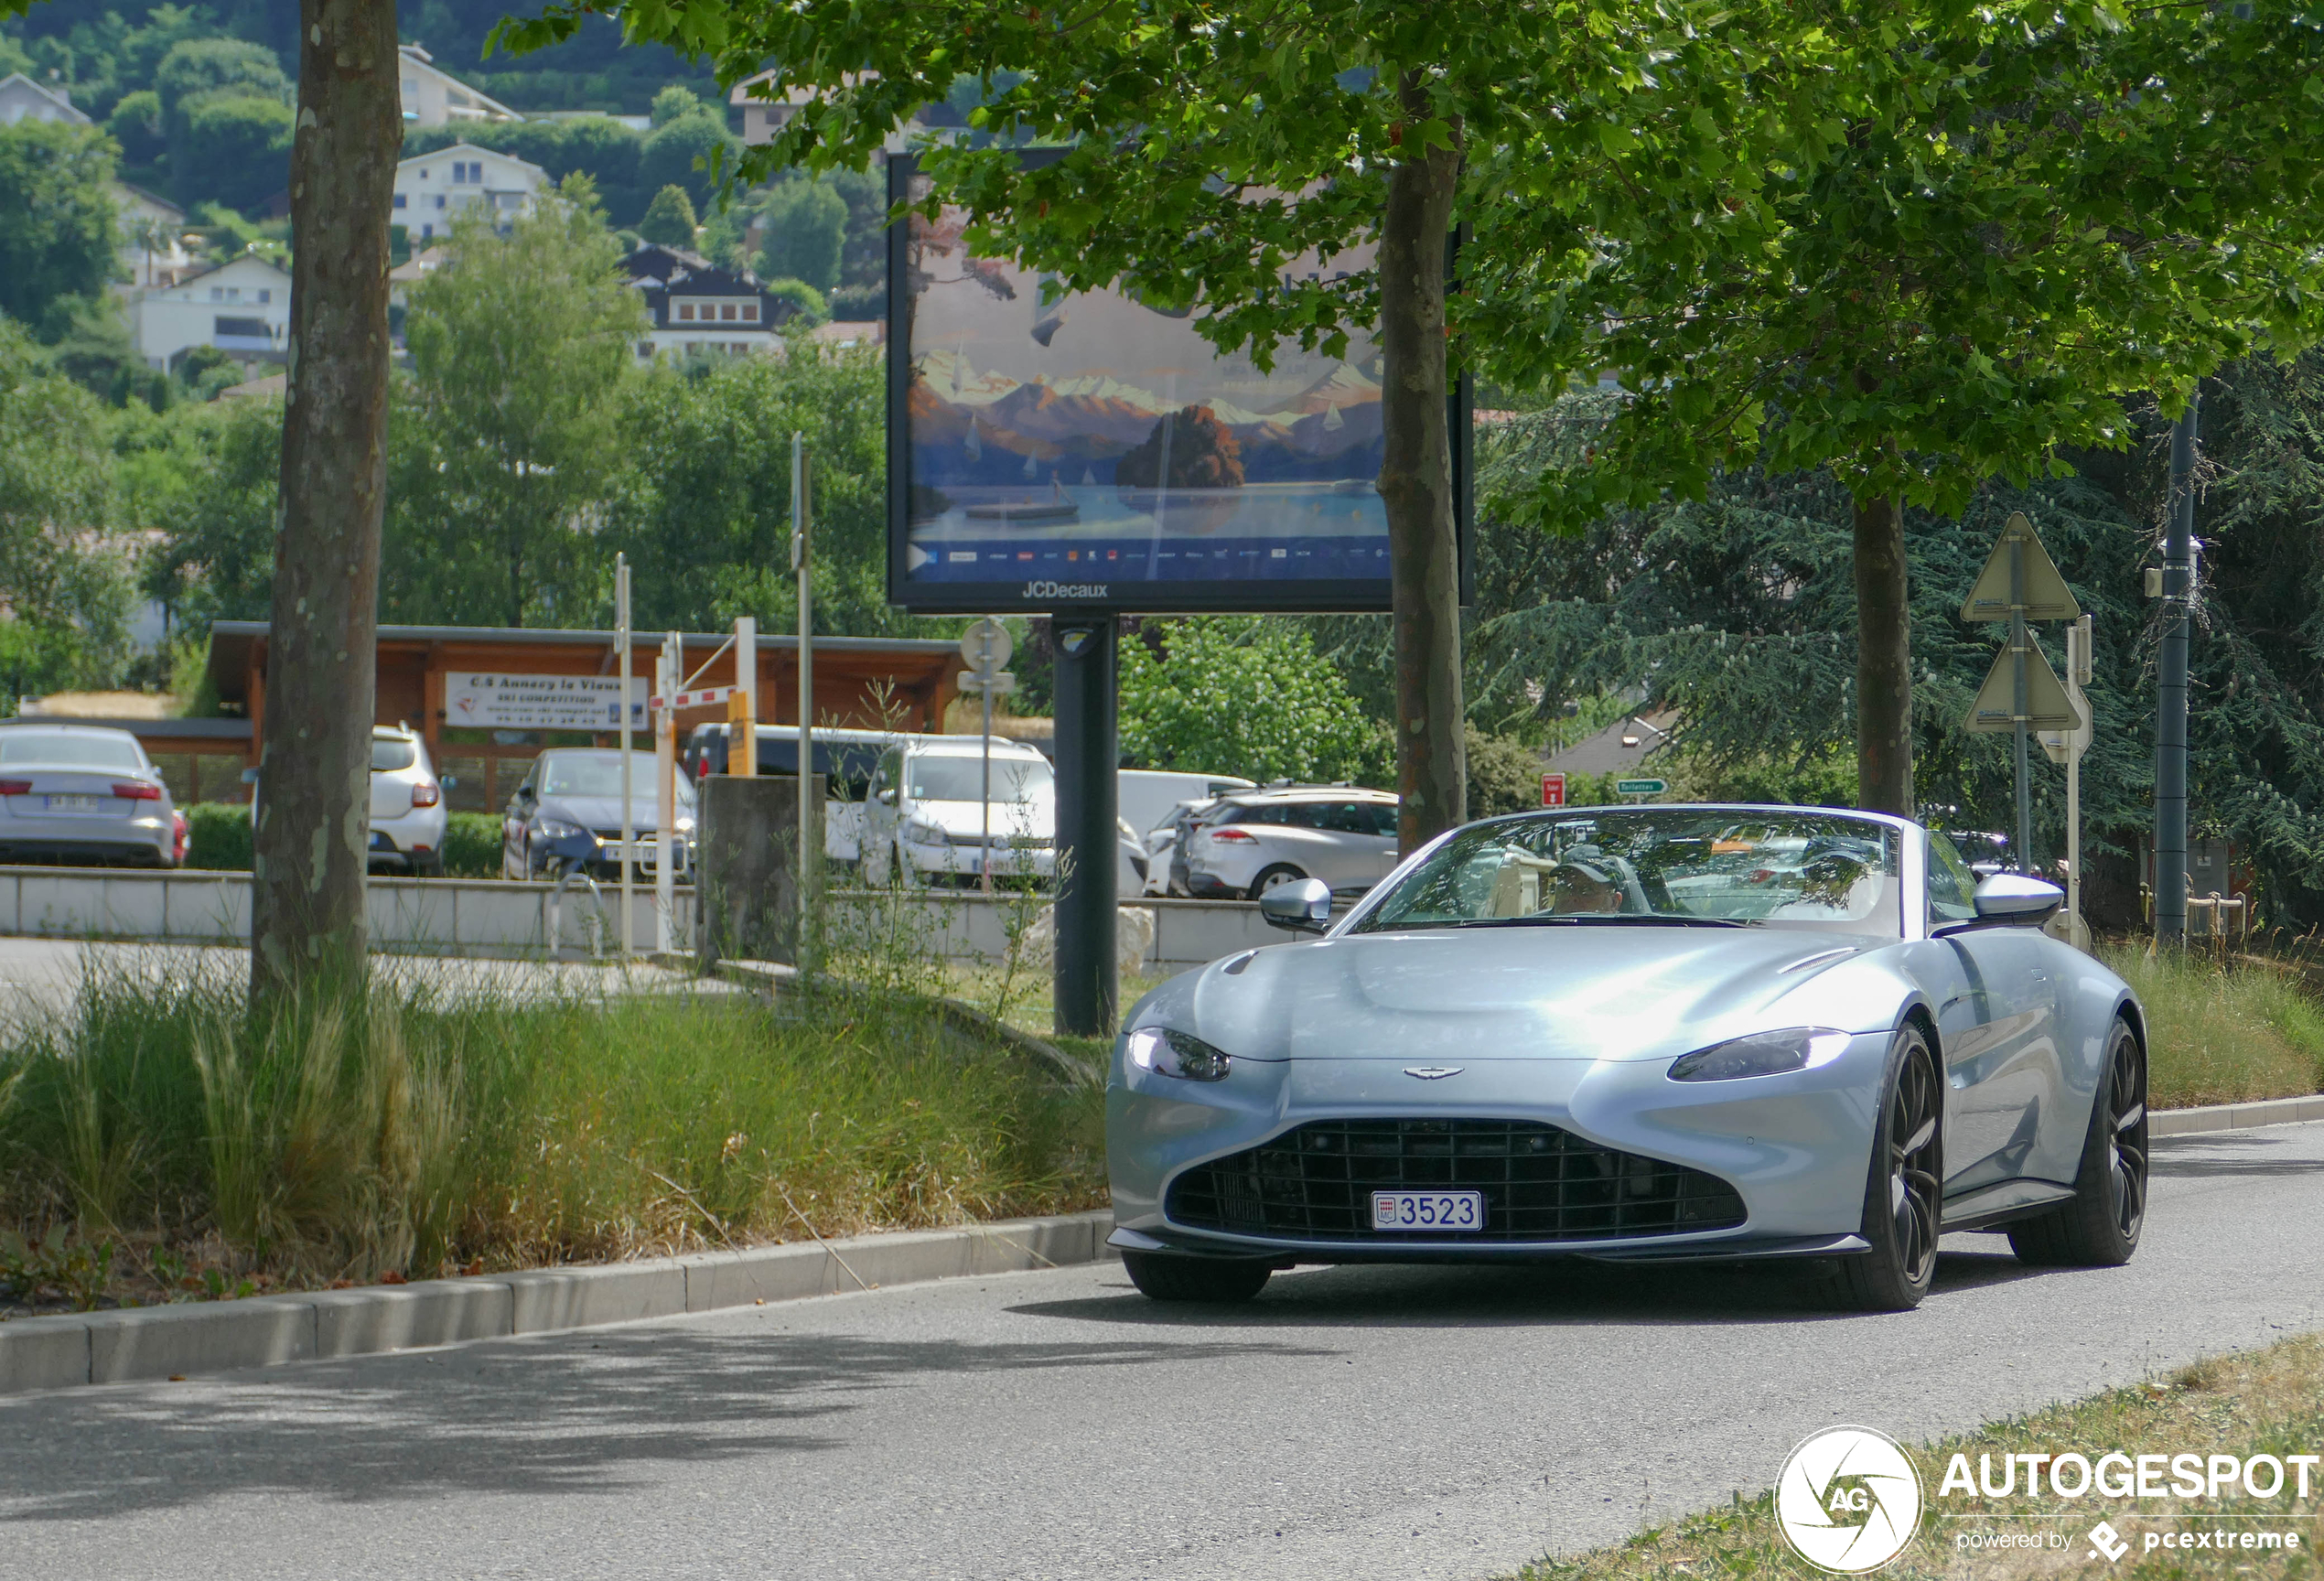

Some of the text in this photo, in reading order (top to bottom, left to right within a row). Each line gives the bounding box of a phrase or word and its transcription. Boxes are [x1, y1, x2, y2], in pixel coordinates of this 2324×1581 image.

[1022, 580, 1108, 598] JCDecaux
[500, 677, 555, 692] Annecy
[561, 679, 575, 690] le
[497, 694, 597, 704] SKI COMPETITION
[1620, 782, 1654, 791] Toilettes
[1380, 1197, 1475, 1225] MC 3523
